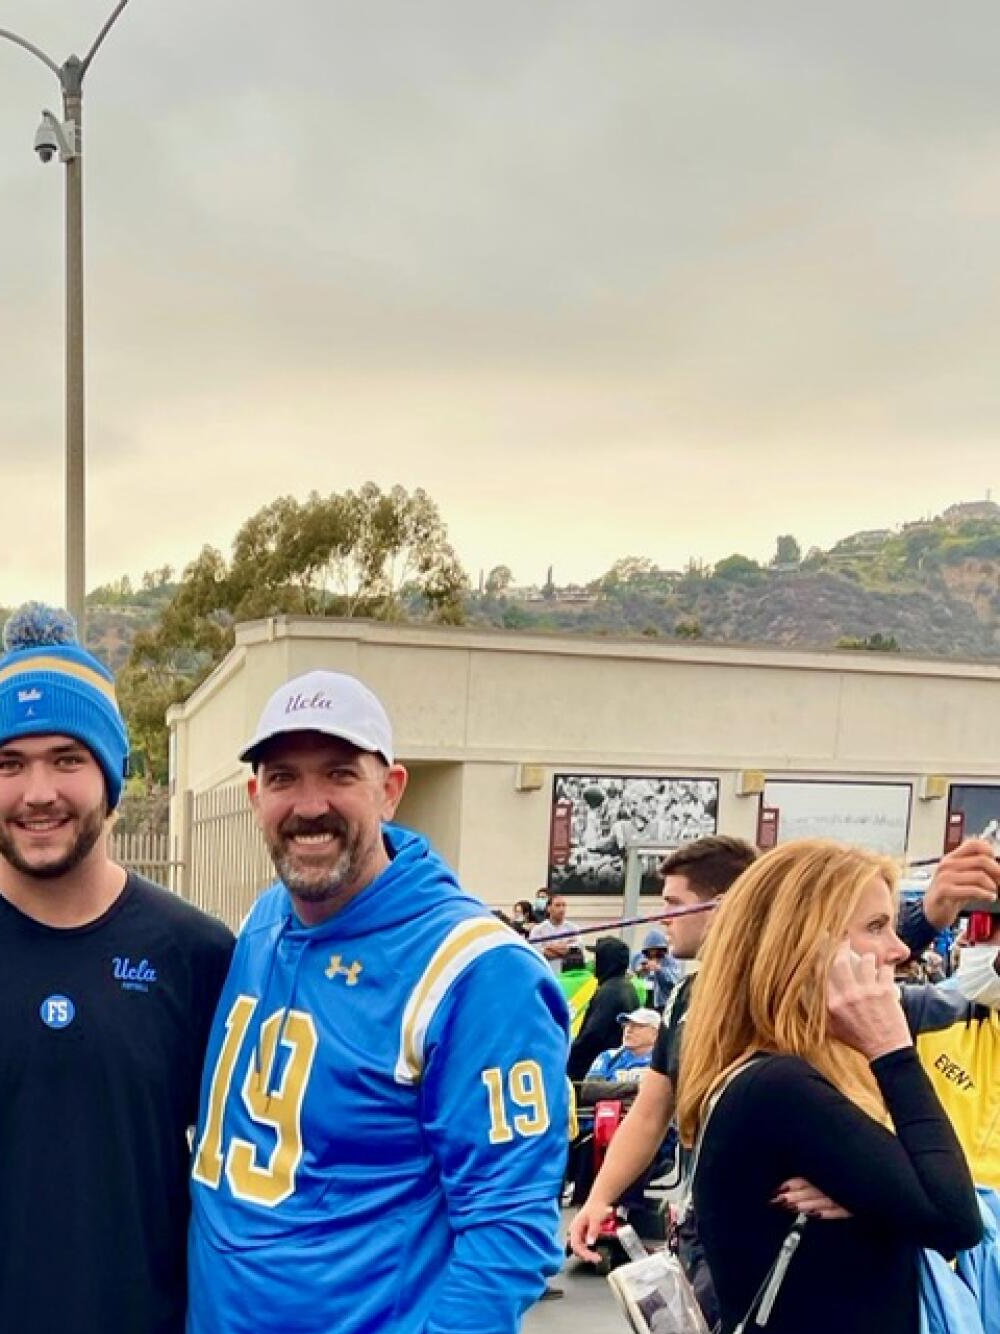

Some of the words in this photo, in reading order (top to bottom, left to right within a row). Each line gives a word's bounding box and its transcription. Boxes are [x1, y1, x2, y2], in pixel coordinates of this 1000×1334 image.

[284, 690, 333, 714] Ucla
[111, 956, 158, 982] Ucla
[934, 1053, 975, 1091] EVENT
[191, 993, 319, 1208] 19
[481, 1059, 551, 1145] 19
